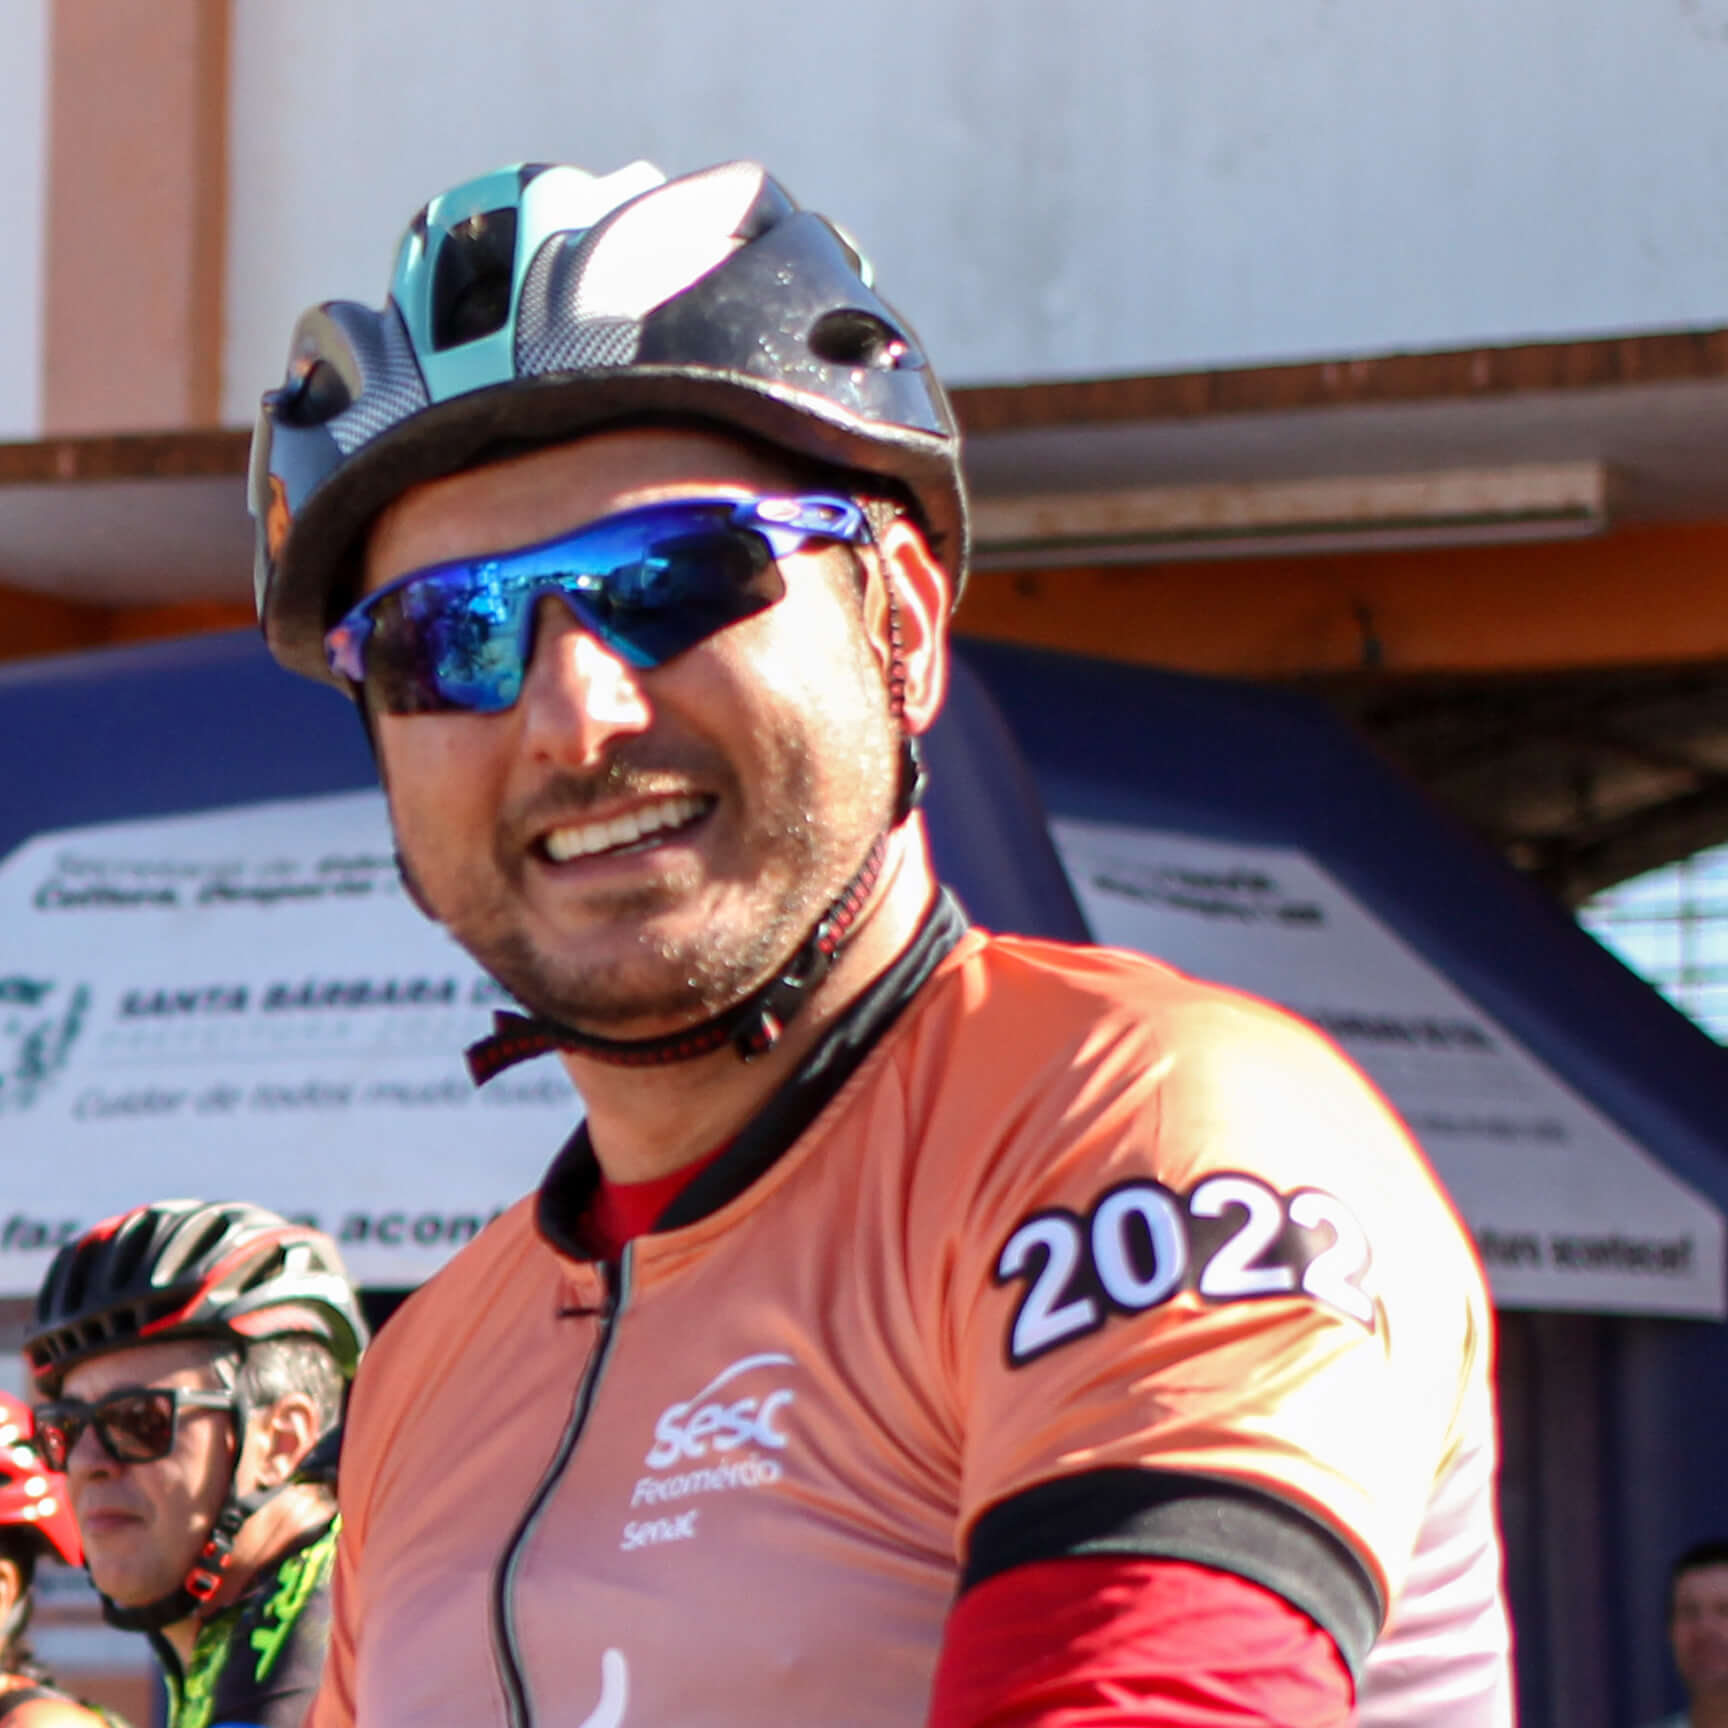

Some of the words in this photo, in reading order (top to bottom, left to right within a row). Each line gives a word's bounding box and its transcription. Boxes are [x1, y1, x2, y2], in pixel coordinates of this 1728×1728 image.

[119, 984, 247, 1018] SANTA
[261, 975, 456, 1013] BÁRBARA
[996, 1173, 1376, 1363] 2022
[644, 1388, 795, 1470] Sesc
